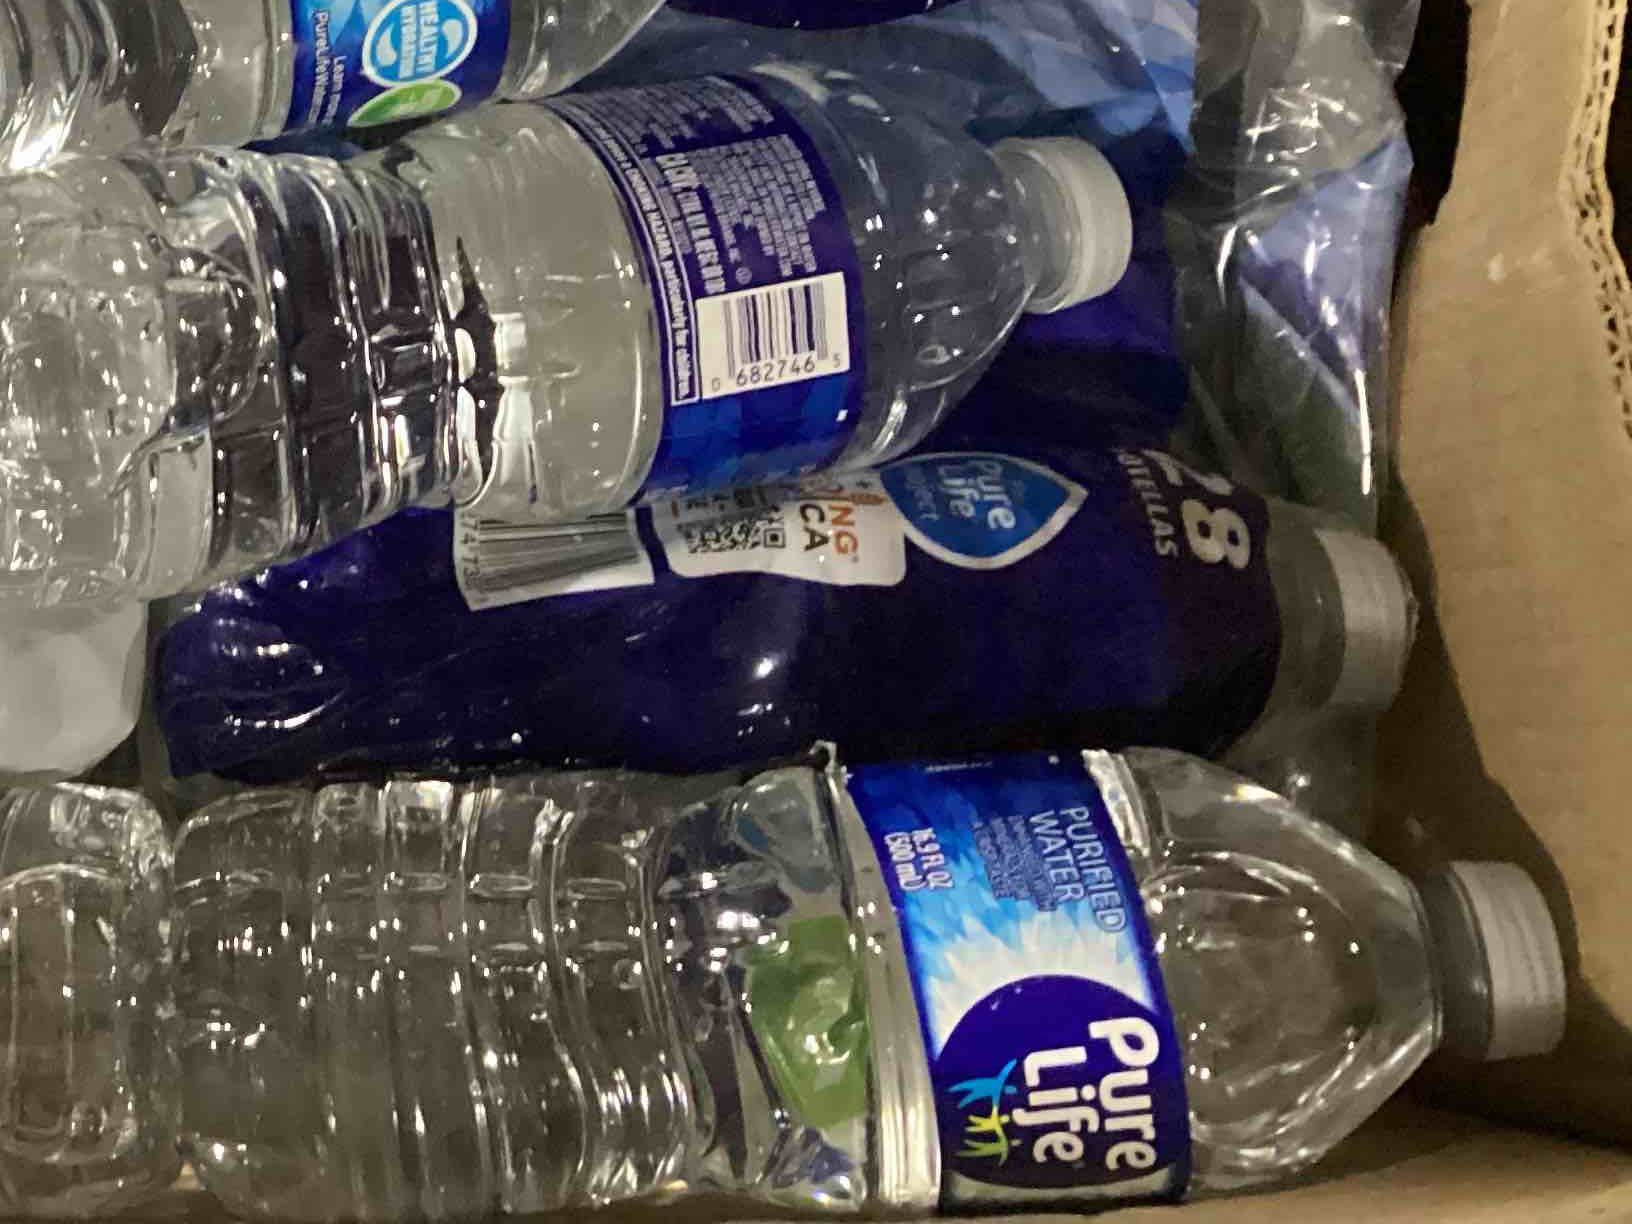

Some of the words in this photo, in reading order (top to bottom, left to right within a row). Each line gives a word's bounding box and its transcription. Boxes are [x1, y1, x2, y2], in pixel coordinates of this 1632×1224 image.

[736, 356, 815, 387] 682746
[1116, 453, 1179, 557] OTELLAS
[1029, 809, 1085, 901] WATER
[1060, 806, 1126, 933] PURIFIED
[1011, 1046, 1100, 1164] Life
[1088, 1016, 1160, 1171] Pure
